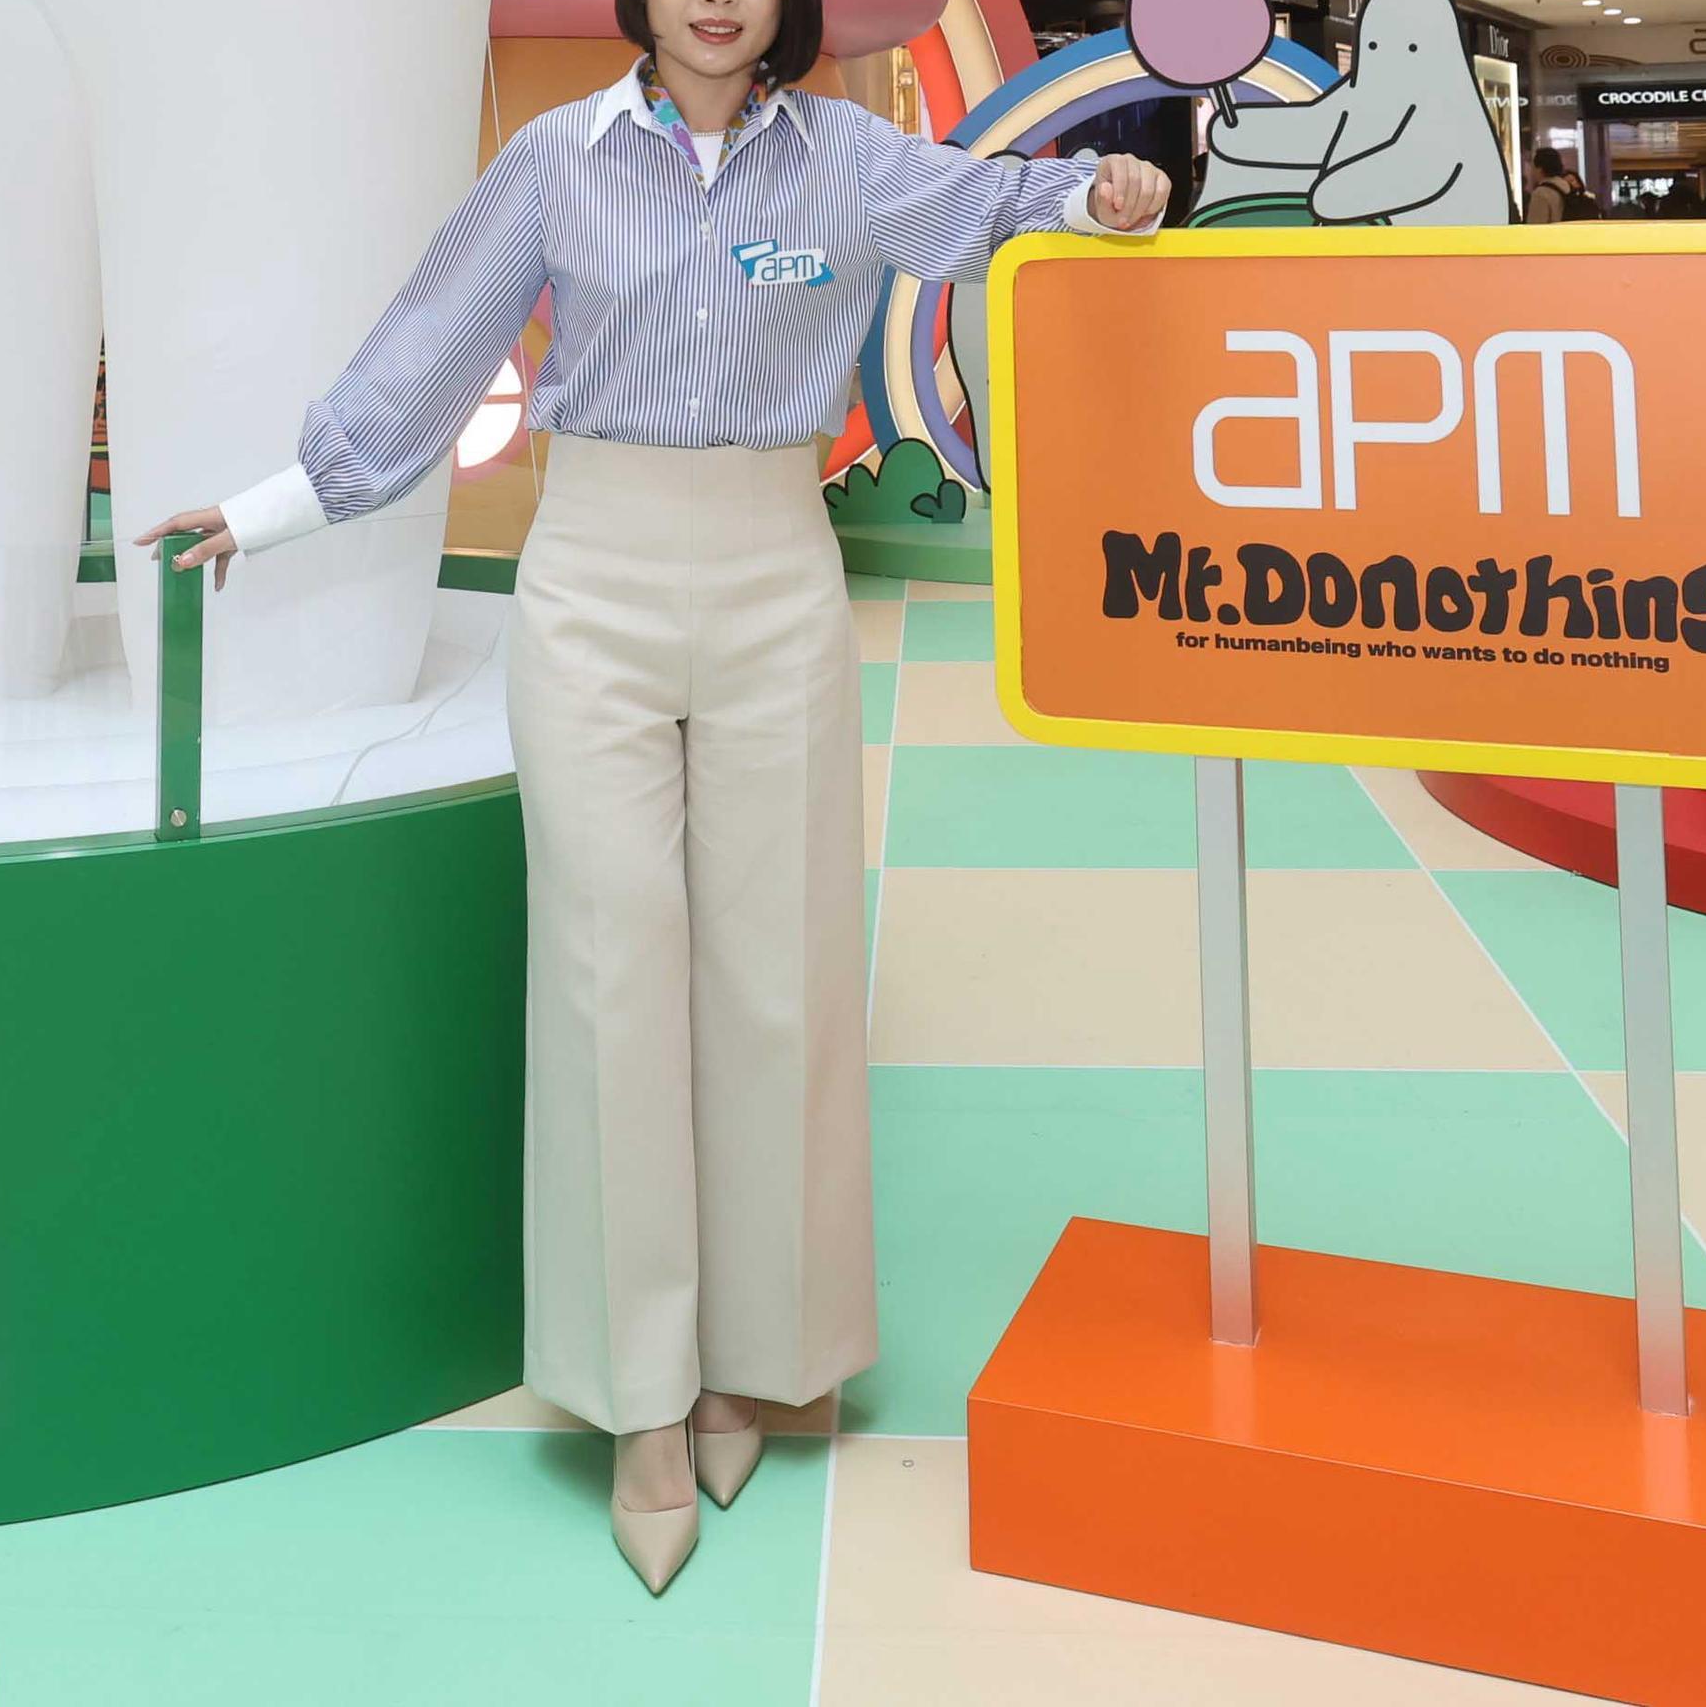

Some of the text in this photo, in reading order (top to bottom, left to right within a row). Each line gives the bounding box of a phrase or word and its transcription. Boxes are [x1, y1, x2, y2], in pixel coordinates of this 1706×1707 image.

[1489, 25, 1510, 58] Dior
[1598, 92, 1689, 105] CROCODILE
[1175, 631, 1670, 674] for humanbeing who wants to do nothing
